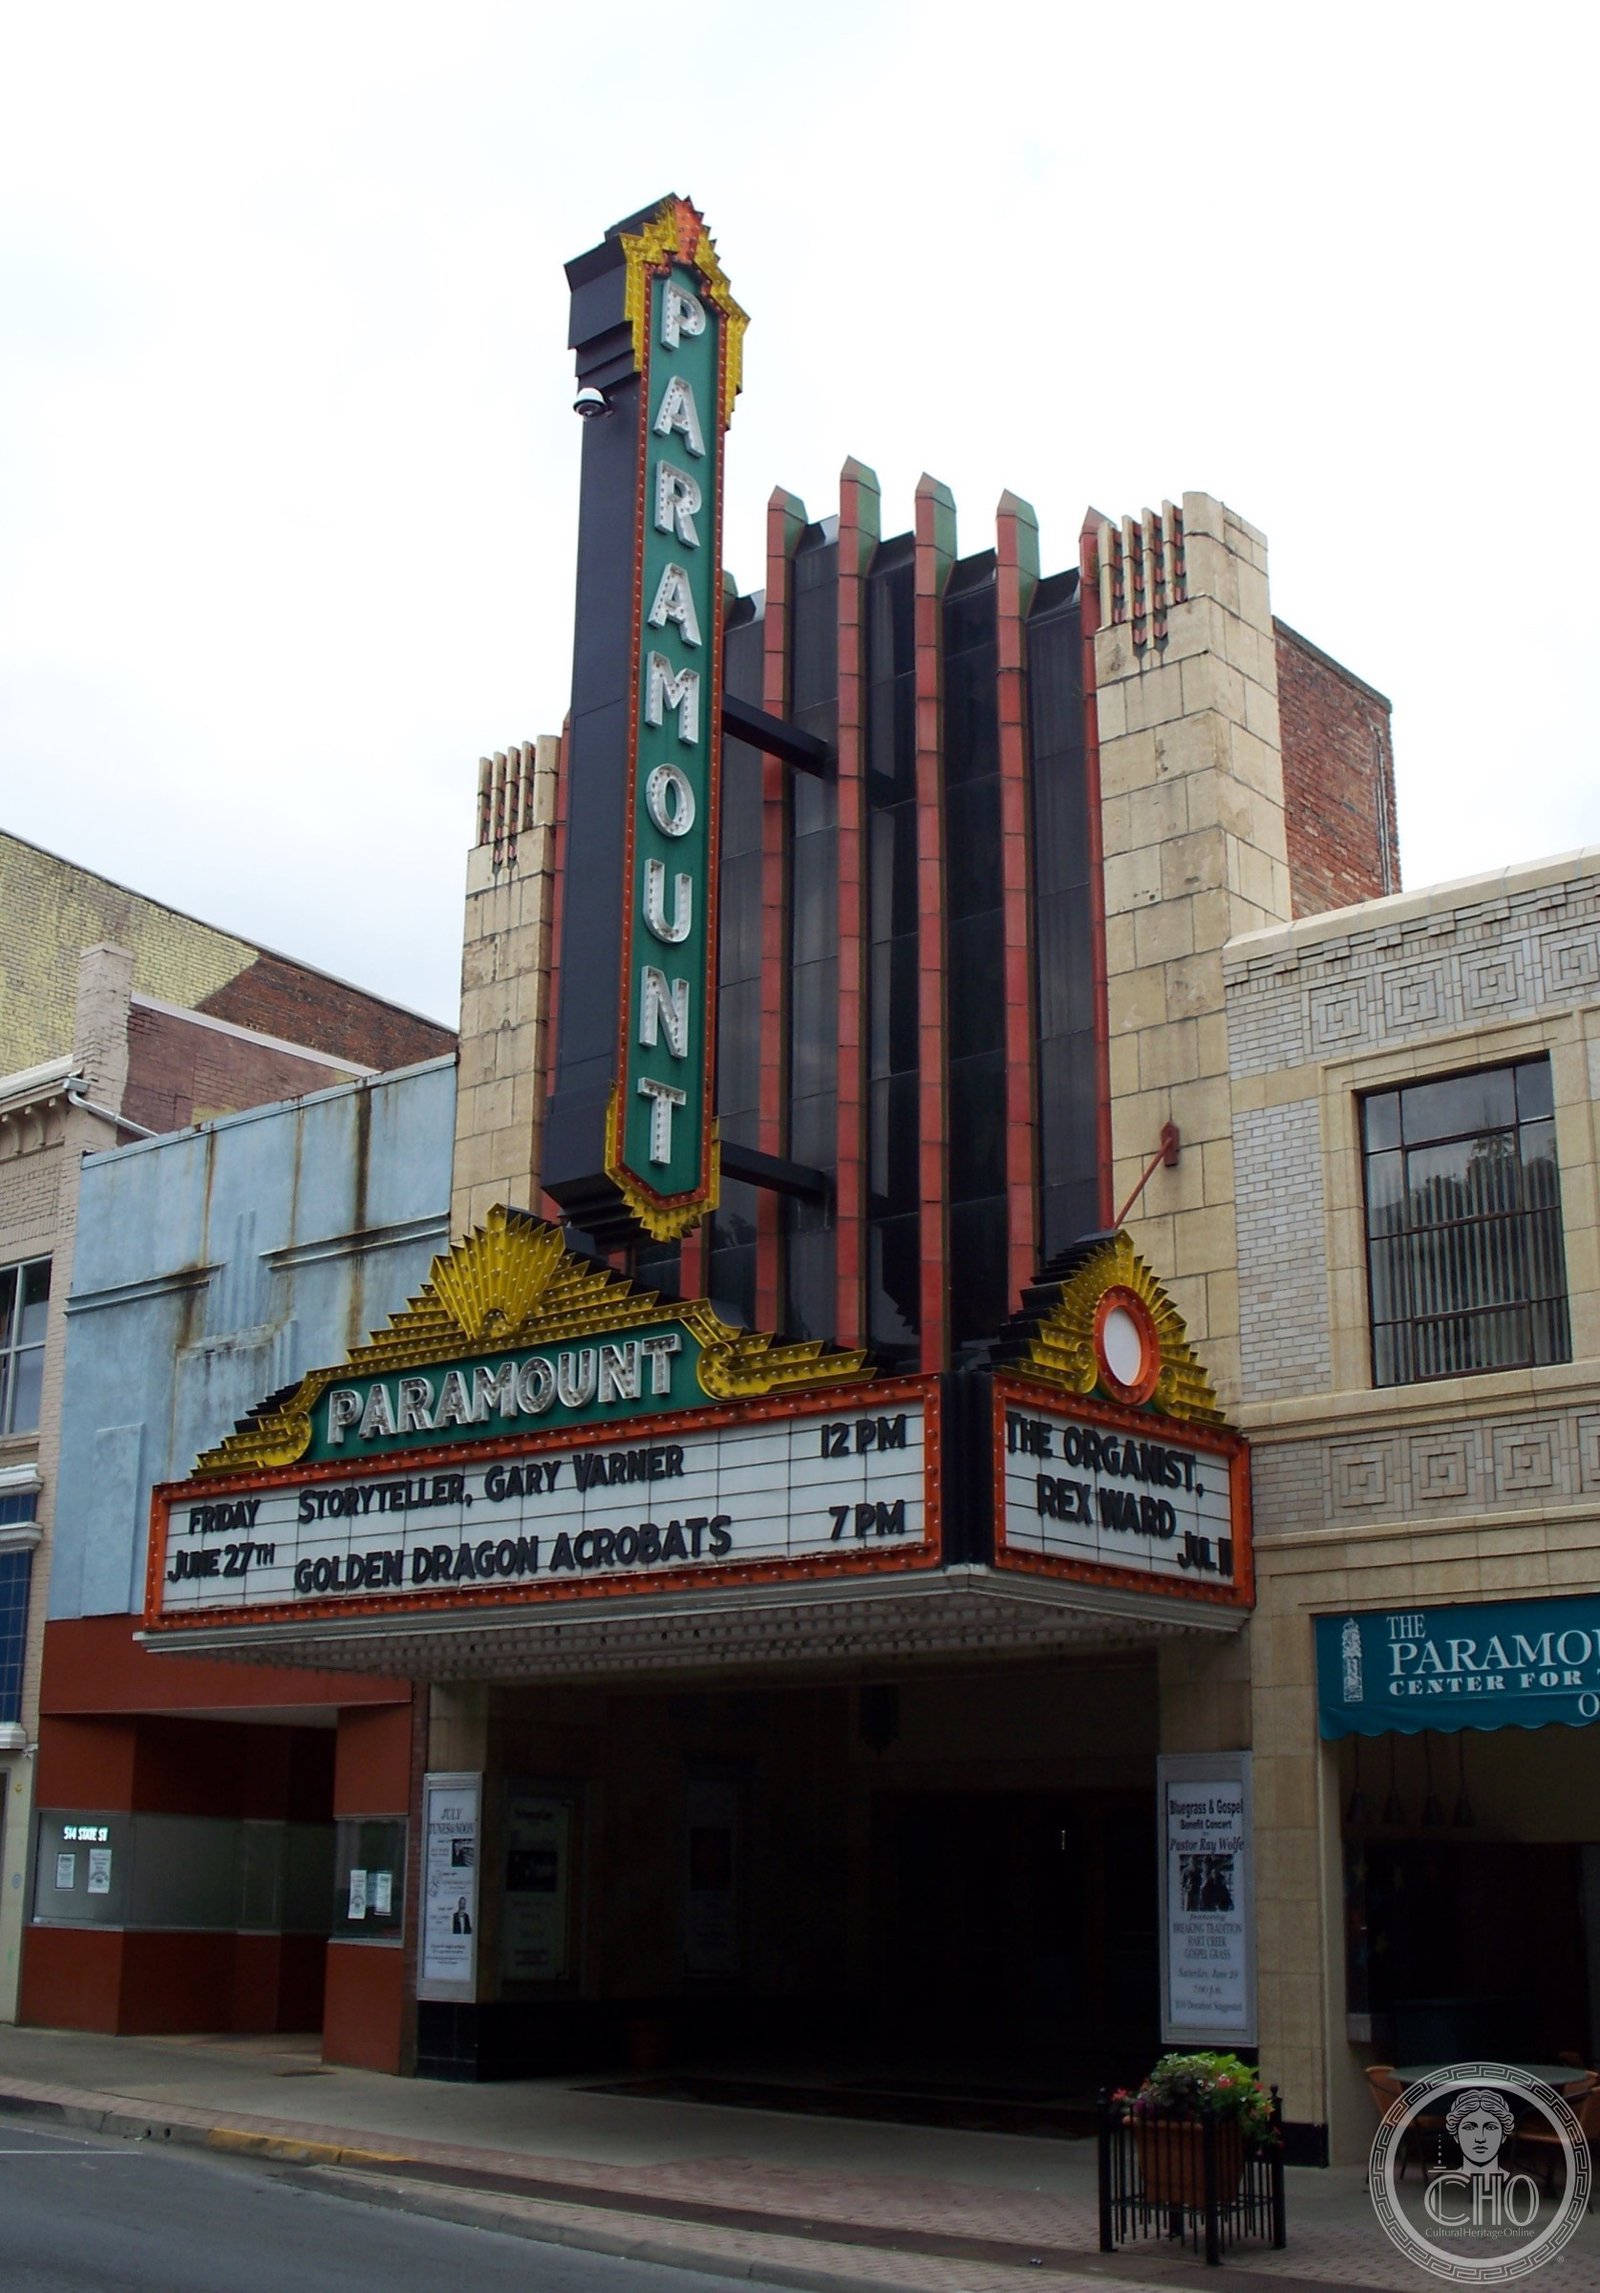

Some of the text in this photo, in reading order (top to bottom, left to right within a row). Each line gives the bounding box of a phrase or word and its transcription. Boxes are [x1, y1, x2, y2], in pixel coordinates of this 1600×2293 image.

[636, 279, 707, 1165] PARAMOUNT
[327, 1332, 682, 1443] PARAMOUNT
[821, 1414, 906, 1458] 12 PM
[1007, 1411, 1053, 1458] THE
[299, 1445, 685, 1524] STORYTELLER, GARY VARNER
[189, 1499, 261, 1534] FRIDAY
[829, 1499, 906, 1541] 7 PM
[1036, 1473, 1176, 1540] REX WARD
[167, 1547, 222, 1583] JUNE
[294, 1514, 732, 1594] GOLDEN DRAGON ACROBATS
[1177, 1530, 1216, 1570] JUL
[1386, 1614, 1426, 1640] THE
[1387, 1628, 1600, 1676] PARAMO
[1388, 1675, 1506, 1697] CENTER
[1520, 1670, 1583, 1688] FOR
[1217, 1798, 1244, 1818] Gospel
[78, 1826, 98, 1841] STATE
